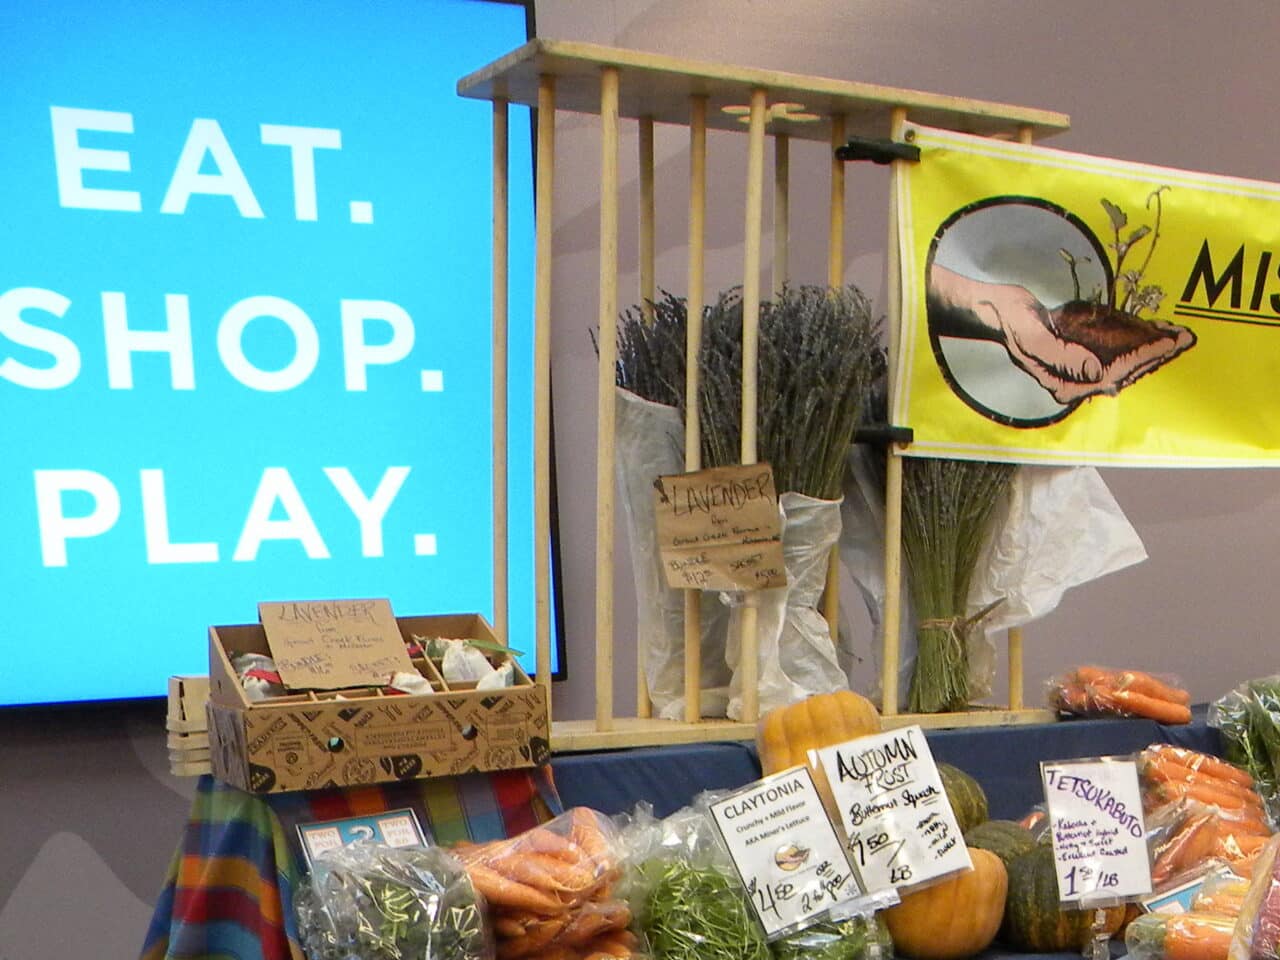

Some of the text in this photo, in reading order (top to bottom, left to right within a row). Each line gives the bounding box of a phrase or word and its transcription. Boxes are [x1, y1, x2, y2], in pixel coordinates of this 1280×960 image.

[50, 106, 374, 225] EAT.
[0, 286, 444, 392] SHOP.
[34, 466, 438, 568] PLAY.
[672, 471, 773, 517] LAVENDER
[836, 729, 918, 782] AUTUMN
[723, 778, 804, 820] CLAYTONIA
[735, 817, 765, 834] Crunchy
[769, 808, 785, 820] Mild
[1046, 769, 1143, 839] TETSUKABUTO
[744, 836, 760, 846] AKA
[785, 815, 810, 829] Lettuce
